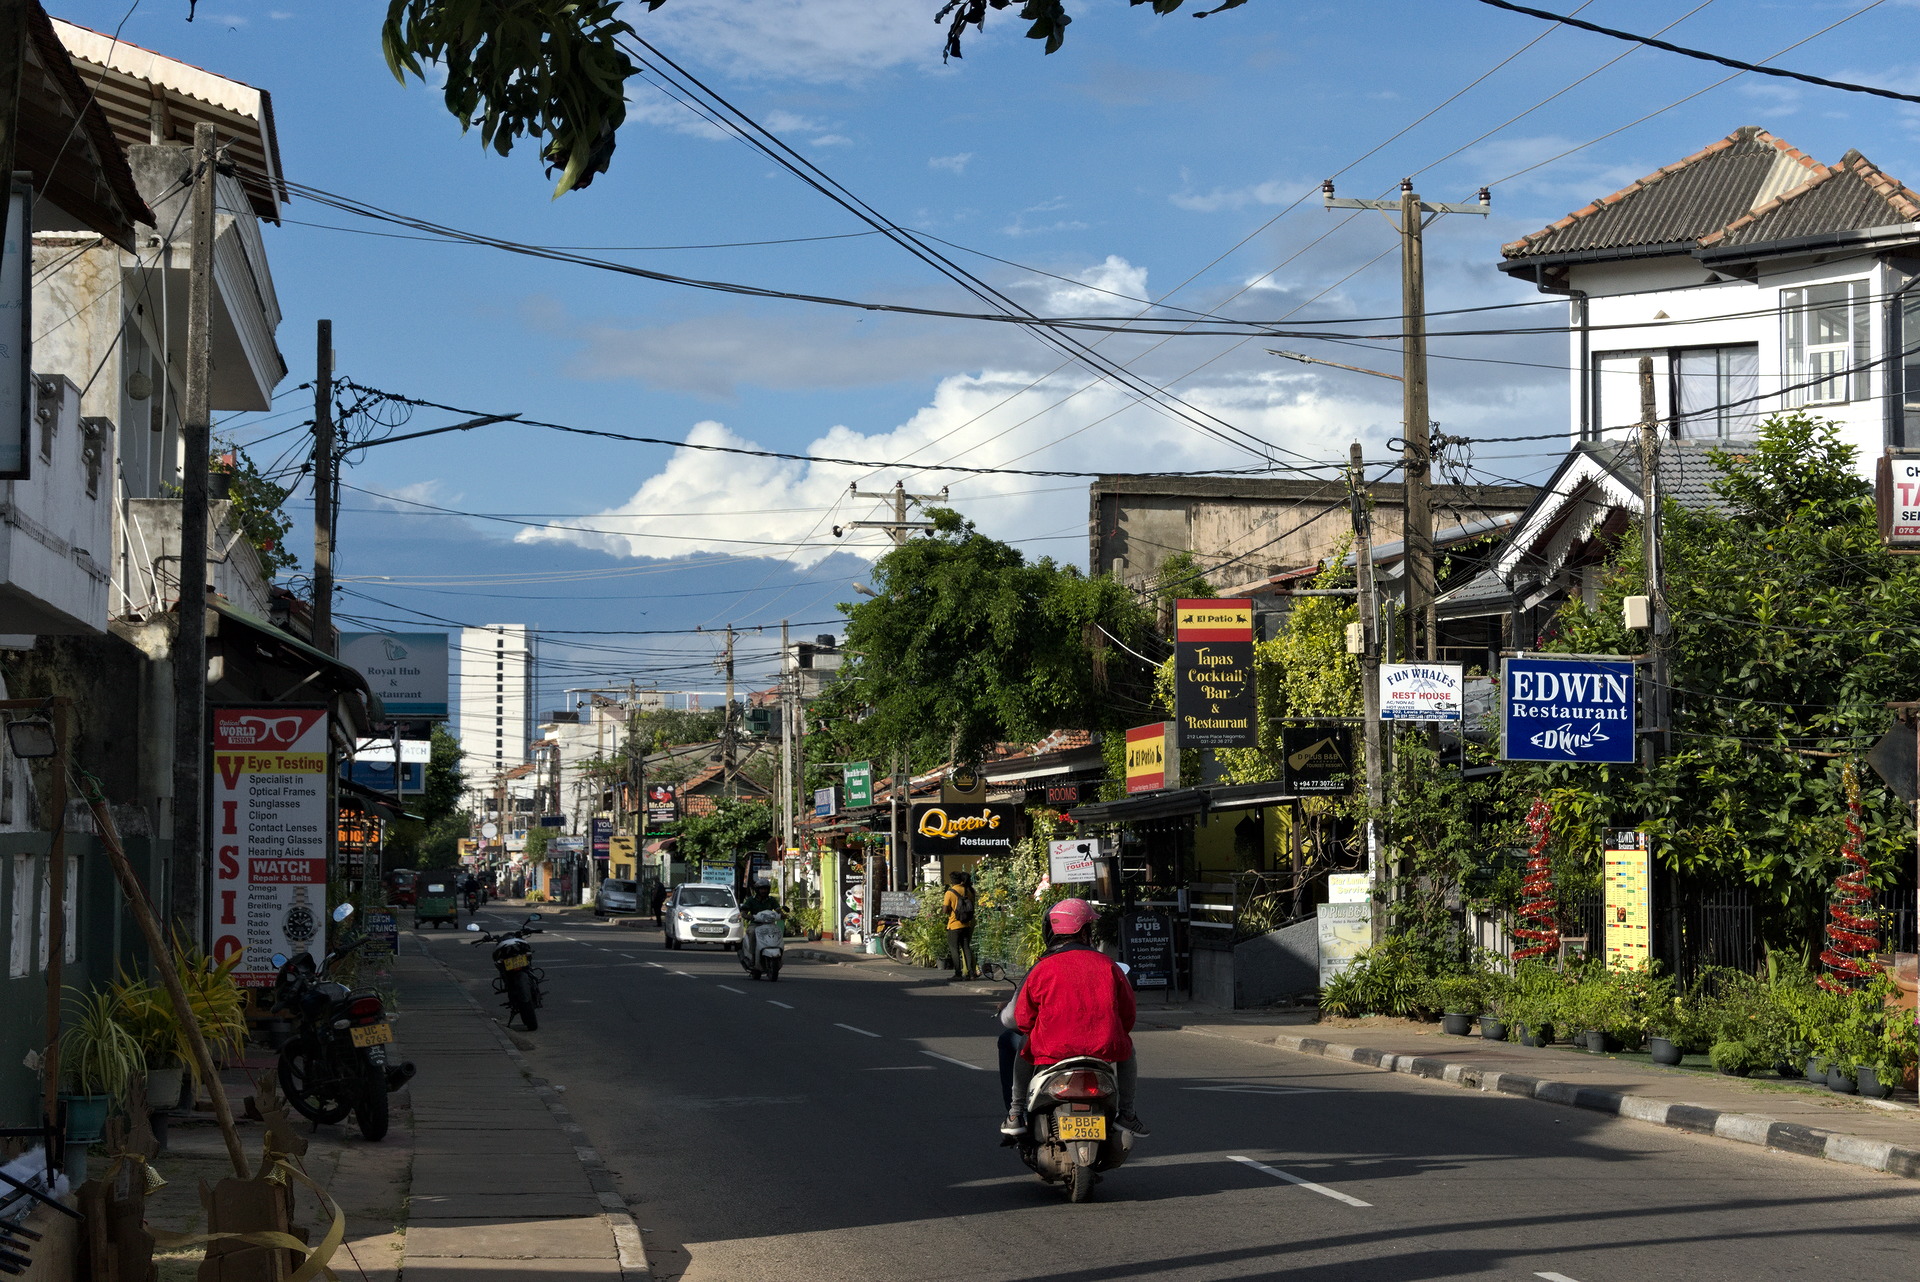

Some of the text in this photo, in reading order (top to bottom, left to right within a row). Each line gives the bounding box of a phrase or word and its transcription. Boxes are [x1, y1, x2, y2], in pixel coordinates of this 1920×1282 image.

[1208, 615, 1233, 623] Patio
[1195, 647, 1233, 668] Tapas
[368, 667, 420, 676] Royal Hub
[1188, 669, 1243, 682] Cocktail
[1387, 669, 1456, 688] FUN WHALES
[1201, 685, 1231, 699] Bar
[1512, 671, 1629, 704] EDWIN
[1419, 692, 1451, 700] HOUSE
[1211, 704, 1220, 713] &
[1512, 703, 1628, 720] Restaurant
[1185, 715, 1248, 729] Restaurant
[219, 727, 256, 736] WORLD
[1136, 747, 1155, 766] El Patio
[248, 756, 323, 772] Eye Testing
[249, 775, 303, 784] Specialist in
[249, 787, 316, 796] Optical Frames
[1050, 787, 1077, 800] ROOMS
[249, 799, 300, 809] Sunglasses
[249, 811, 277, 821] Clipon
[248, 823, 317, 832] Contact Lenses
[918, 808, 1000, 838] Queen's
[248, 835, 322, 845] Reading Glasses
[960, 837, 1010, 846] Restaurant
[248, 847, 304, 857] Hearing Aids
[253, 861, 310, 873] WATCH
[248, 902, 281, 910] Breitling
[1320, 906, 1367, 918] D Plus B&B
[1135, 922, 1160, 931] PUB
[364, 1026, 377, 1035] UC
[1075, 1118, 1097, 1127] BBF
[1074, 1128, 1100, 1137] 2563
